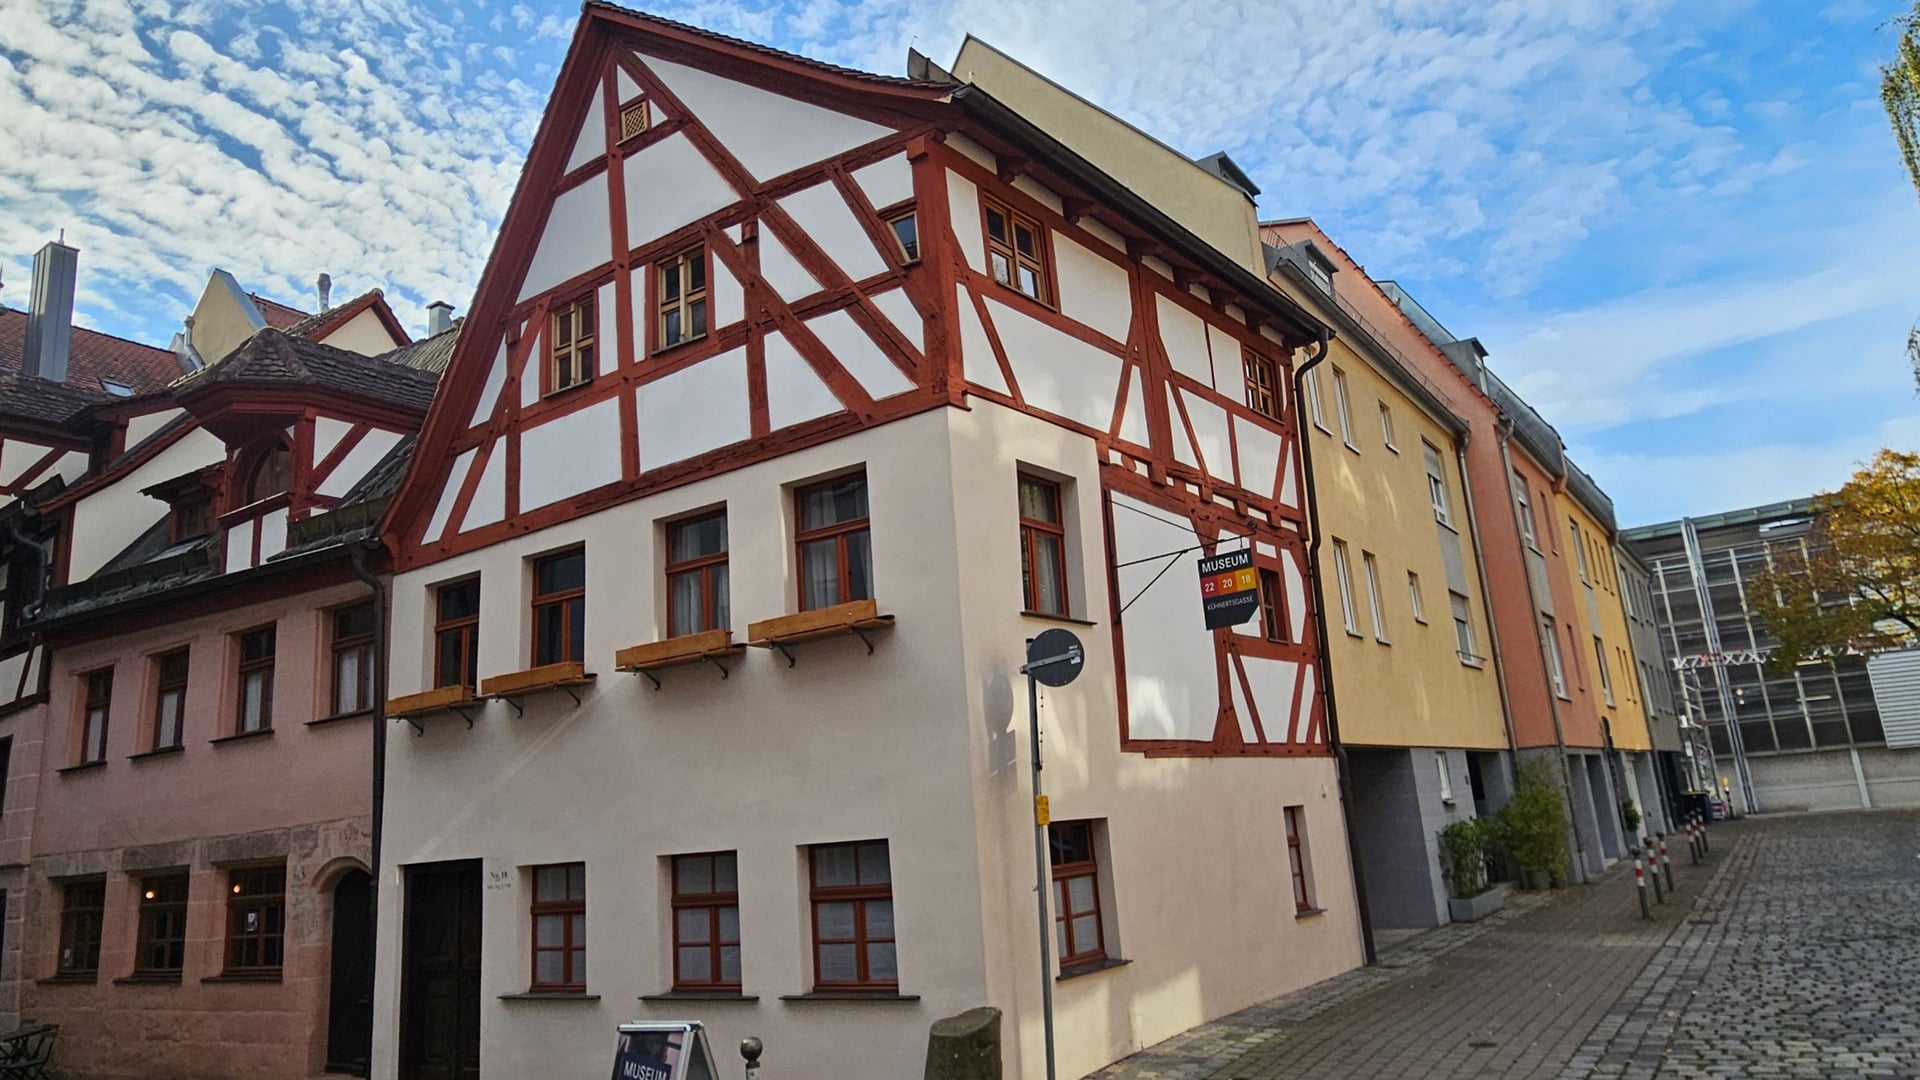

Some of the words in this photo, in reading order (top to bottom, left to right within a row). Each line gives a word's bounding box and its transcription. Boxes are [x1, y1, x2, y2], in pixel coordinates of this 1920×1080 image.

[1202, 553, 1248, 573] MUSEUM
[1204, 582, 1215, 593] 22
[1222, 578, 1233, 589] 20
[1241, 574, 1251, 585] 18
